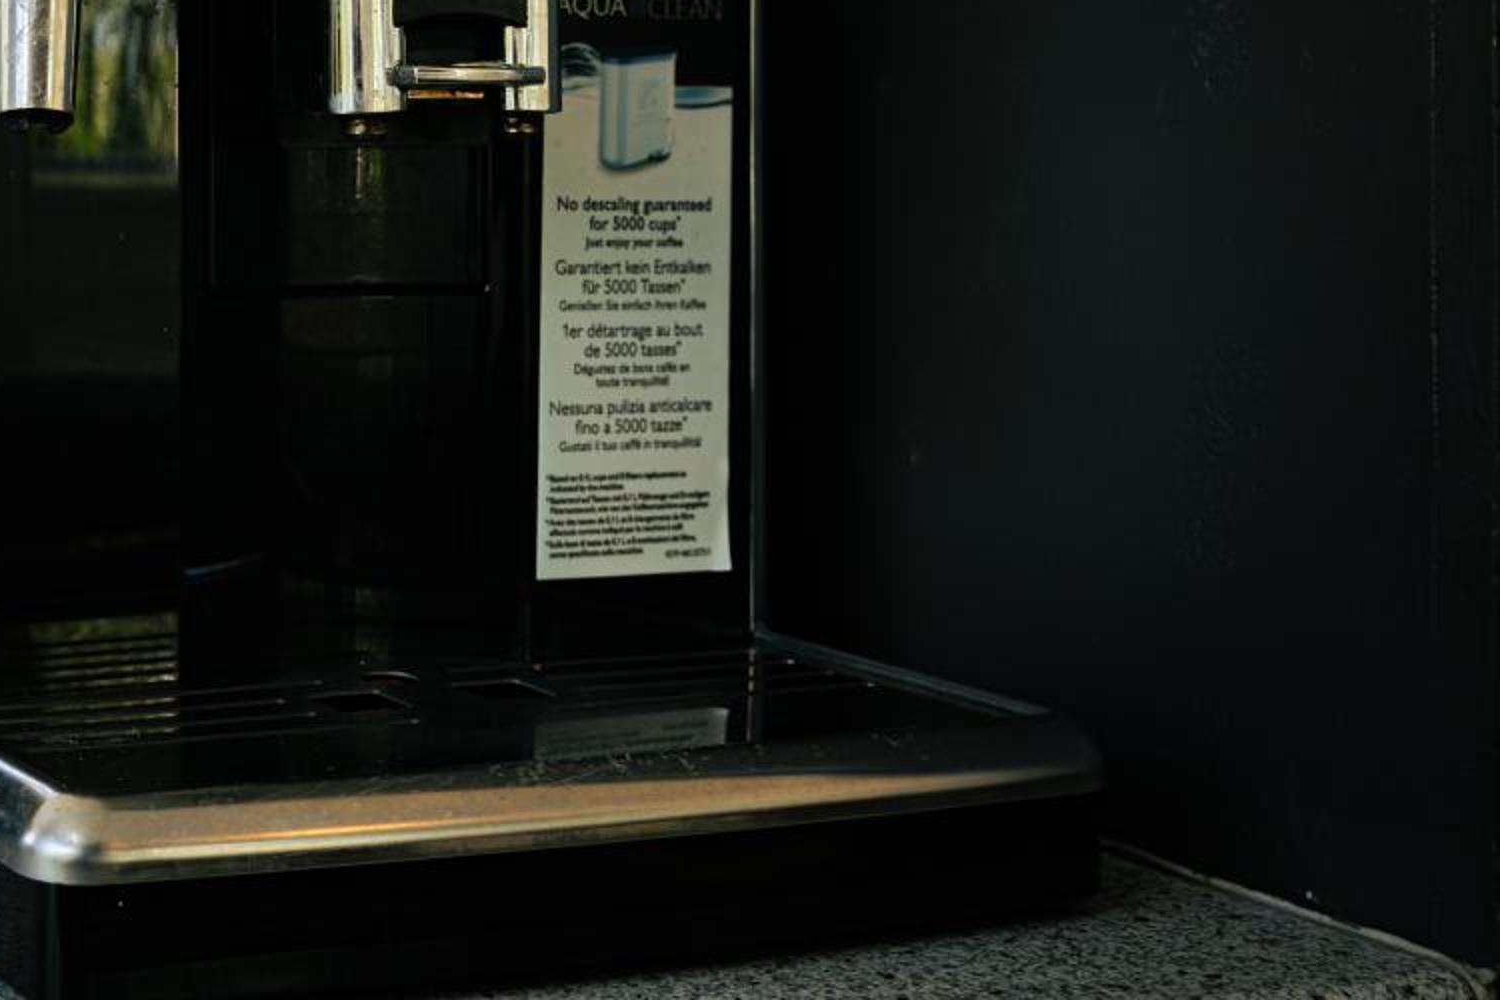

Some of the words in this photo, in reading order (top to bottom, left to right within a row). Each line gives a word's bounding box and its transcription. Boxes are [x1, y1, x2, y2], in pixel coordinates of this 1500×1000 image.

[556, 195, 578, 212] No
[582, 195, 640, 216] descaling
[643, 195, 713, 216] guaranteed
[589, 215, 608, 232] for
[612, 215, 645, 232] 5000
[555, 258, 621, 276] Garantiert
[625, 259, 650, 276] kein
[653, 258, 712, 276] Entkalken
[582, 278, 600, 295] für
[603, 278, 637, 295] 5000
[562, 322, 583, 340] 1er
[655, 325, 671, 337] au
[674, 322, 704, 338] bout
[583, 341, 601, 359] de
[604, 340, 638, 358] 5000
[549, 399, 603, 417] Nessuna
[606, 397, 645, 418] pulizia
[649, 395, 713, 413] anticalcare
[575, 418, 600, 435] fino
[603, 421, 612, 435] a
[614, 417, 648, 434] 5000
